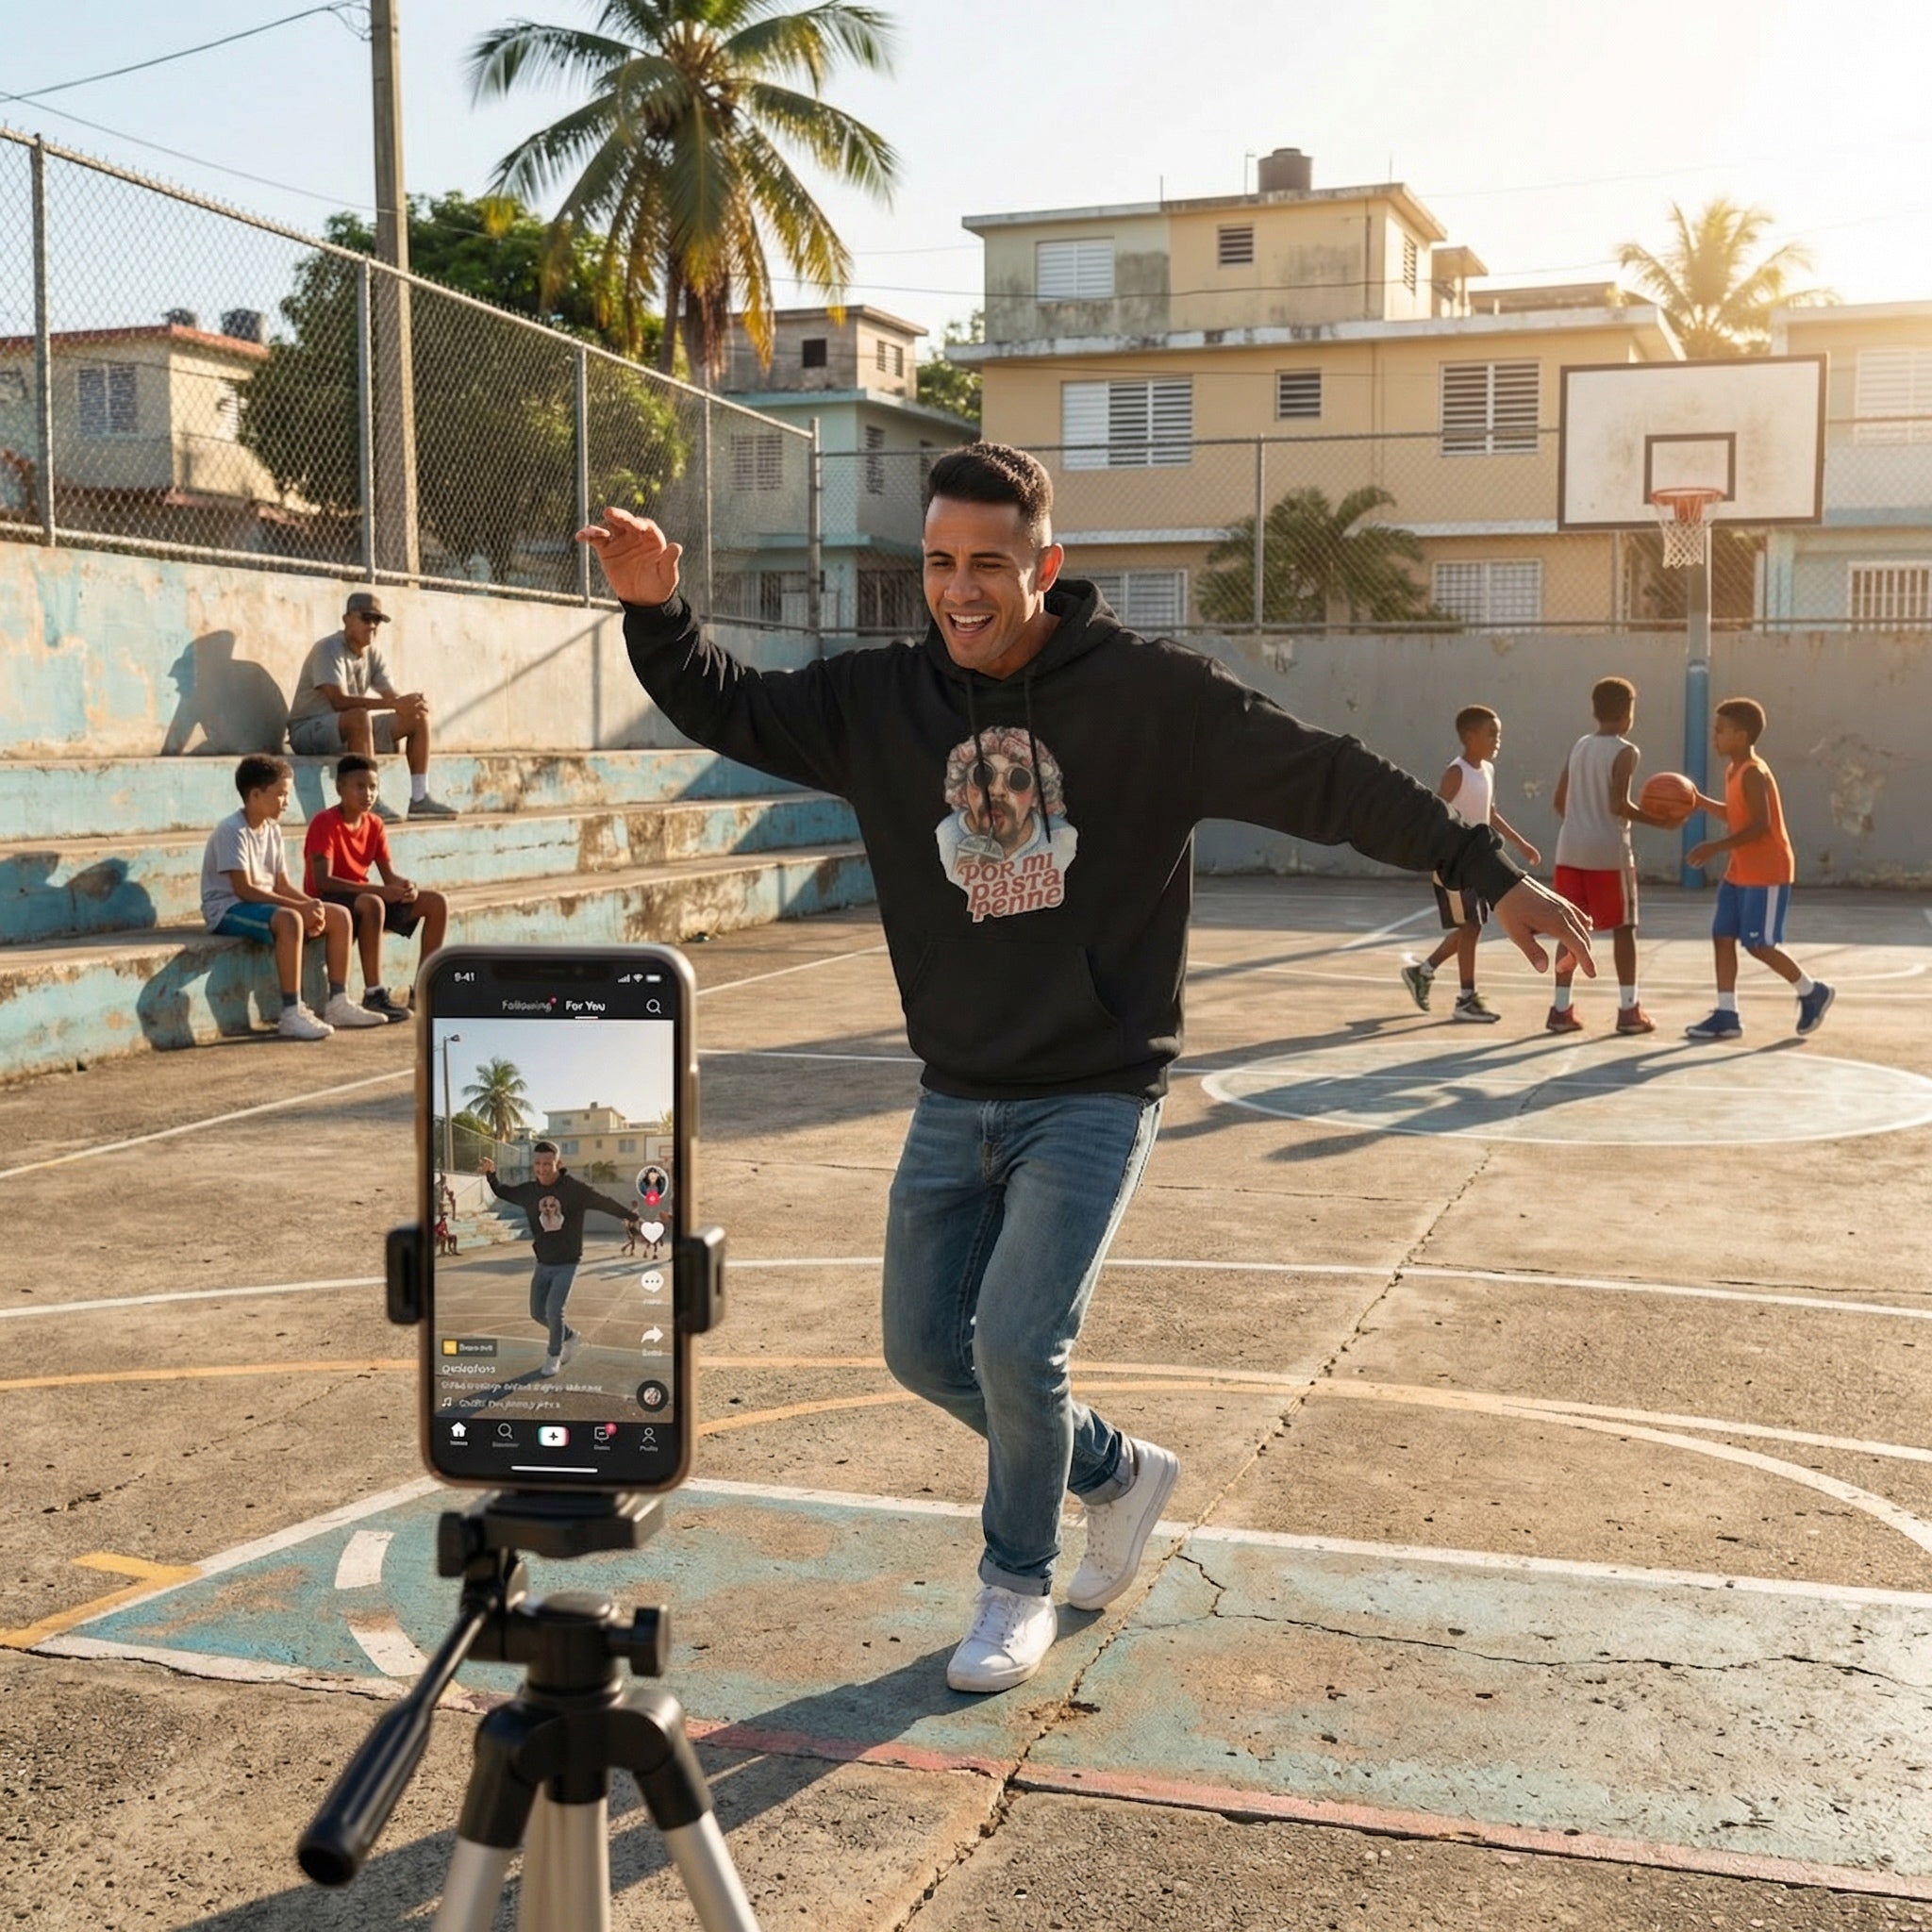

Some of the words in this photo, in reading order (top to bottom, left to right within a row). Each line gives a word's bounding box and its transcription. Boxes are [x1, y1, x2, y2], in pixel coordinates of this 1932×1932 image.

[974, 887, 1062, 920] penne
[565, 1000, 583, 1011] For
[585, 1001, 606, 1011] You
